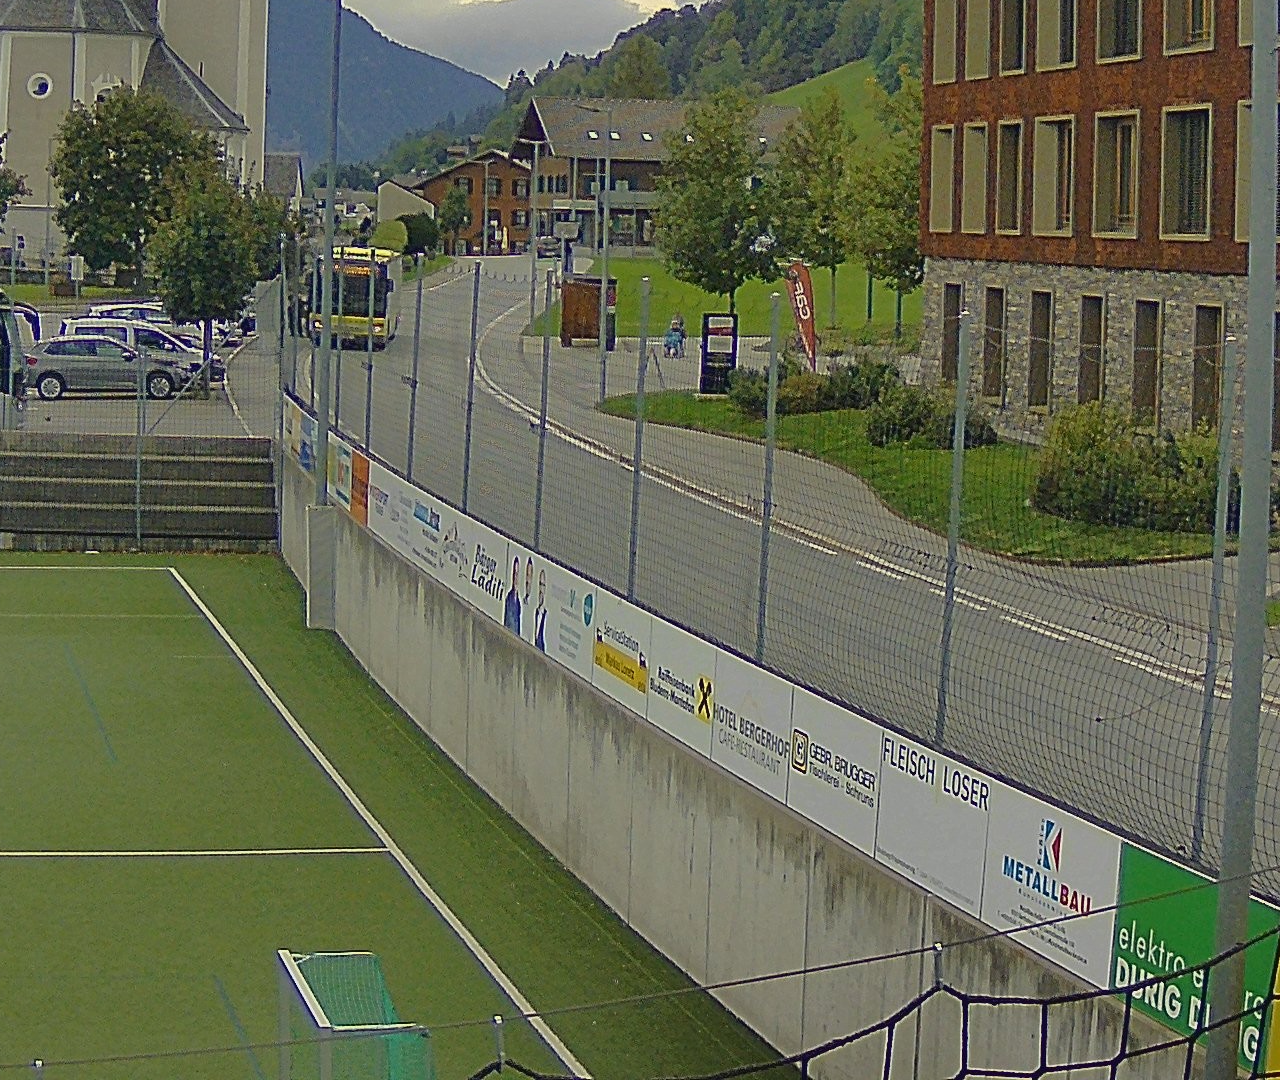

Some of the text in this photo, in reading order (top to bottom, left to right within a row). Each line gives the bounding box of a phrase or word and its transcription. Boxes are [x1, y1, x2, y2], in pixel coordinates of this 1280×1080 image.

[714, 702, 790, 759] HOTEL BERGERHOF
[883, 737, 989, 811] FLEISCH LOSER
[1003, 855, 1091, 916] METALLBAU
[1119, 920, 1186, 978] elektro
